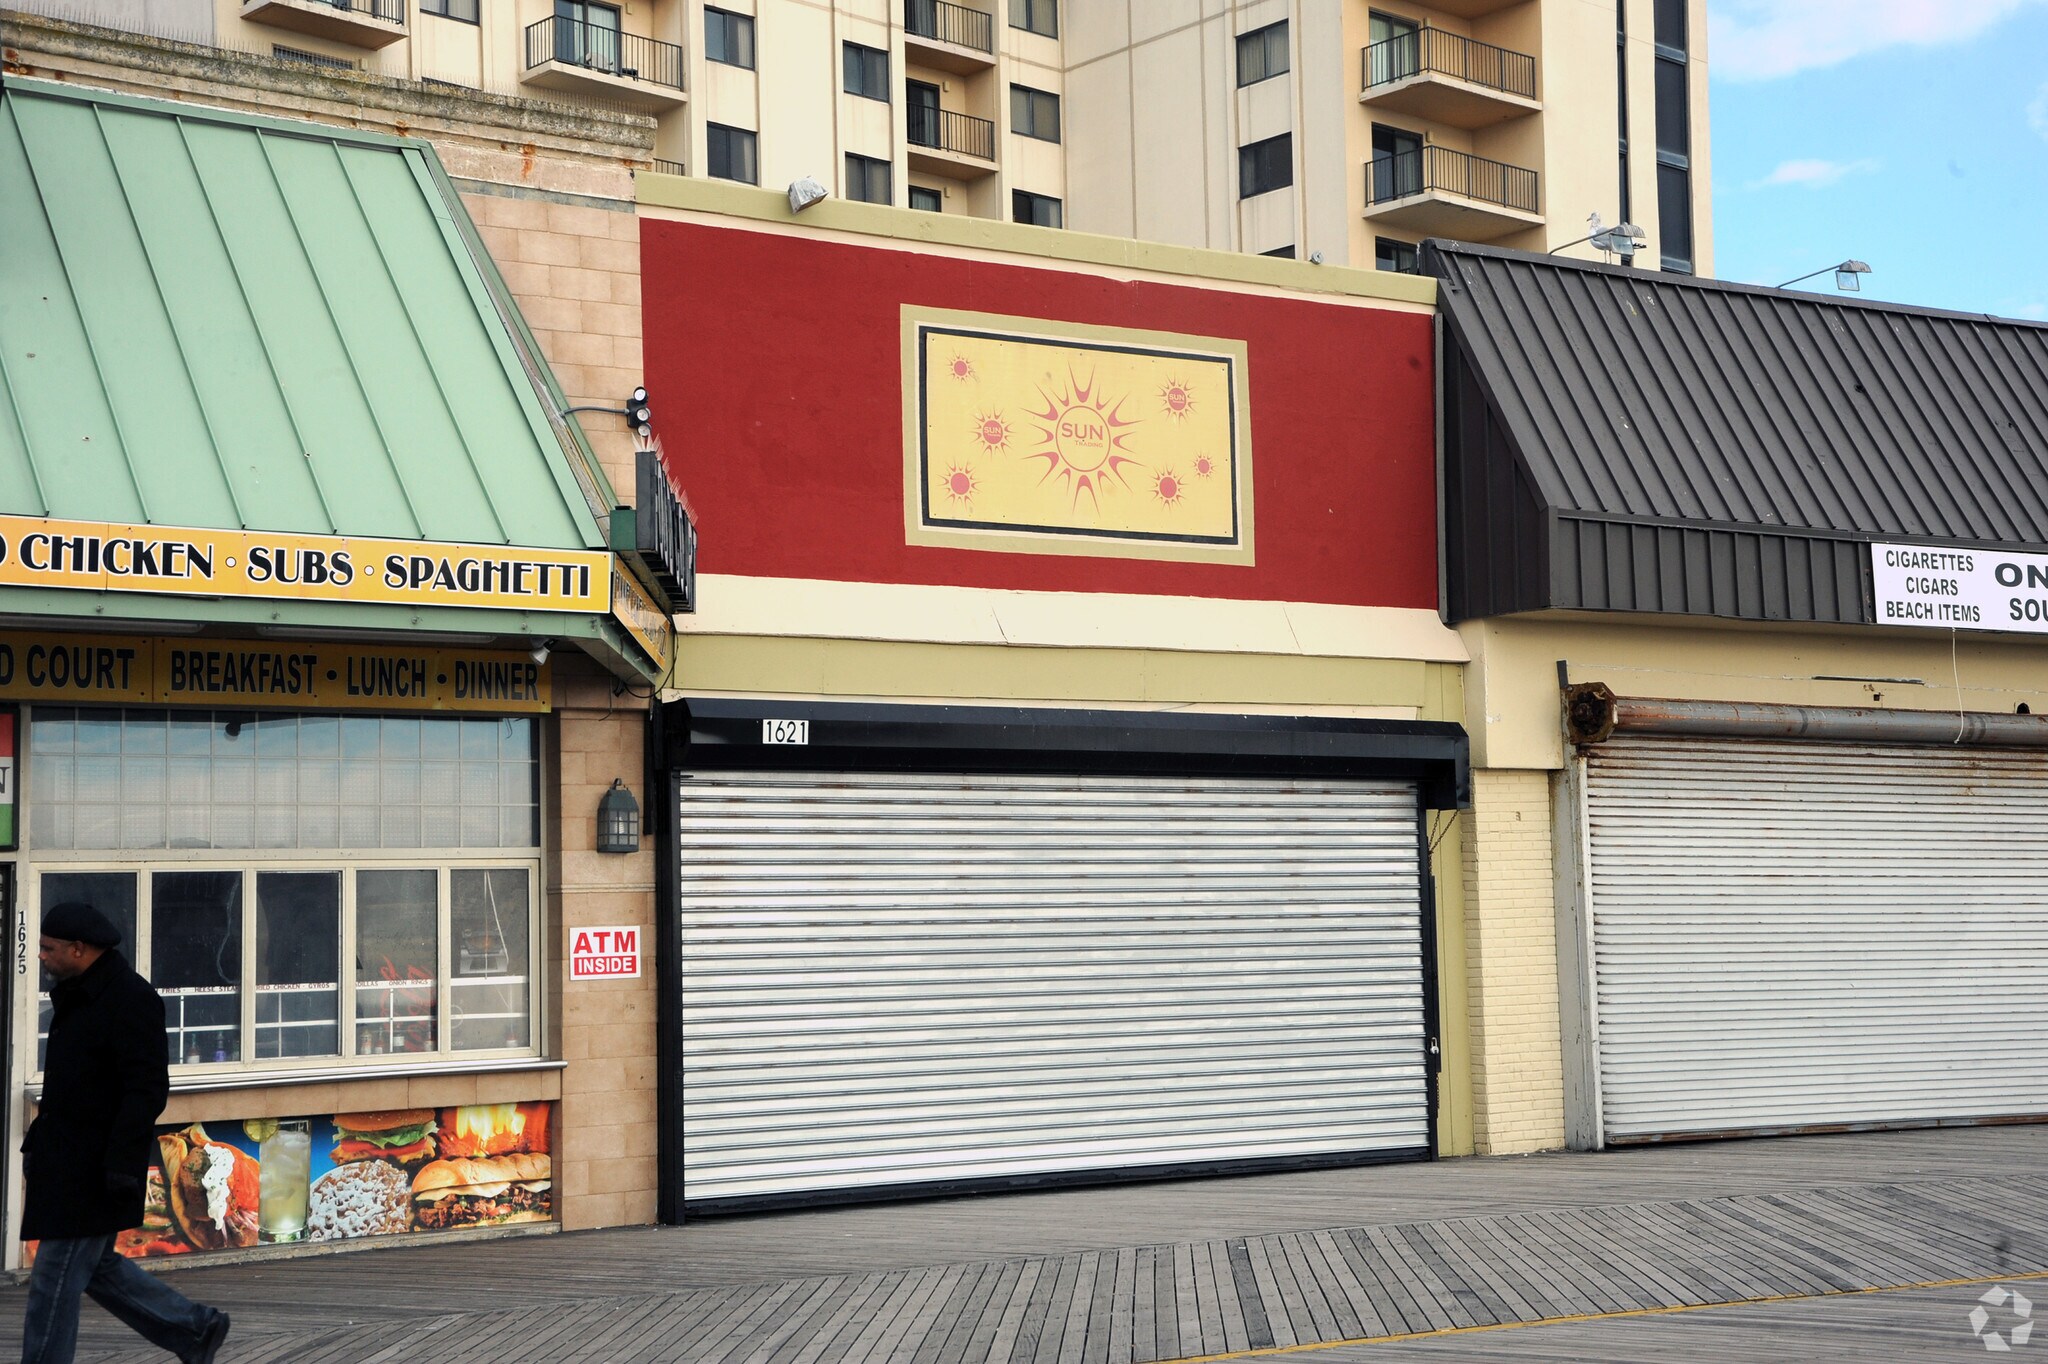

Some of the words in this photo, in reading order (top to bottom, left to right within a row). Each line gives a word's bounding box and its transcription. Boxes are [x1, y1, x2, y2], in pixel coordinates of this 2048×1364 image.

[1061, 422, 1103, 441] SUN
[19, 533, 214, 579] CHICKEN
[247, 546, 353, 586] SUBS
[383, 554, 590, 597] SPAGHETTI
[1885, 549, 1974, 572] CIGARETTES
[1906, 576, 1959, 596] CIGARS
[1886, 600, 1934, 620] BEACH
[1938, 603, 1981, 623] ITEMS
[26, 644, 135, 690] COURT
[171, 650, 317, 695] BREAKFAST
[347, 656, 426, 698] LUNCH
[455, 660, 538, 701] DINNER
[766, 720, 806, 743] 1621
[18, 910, 27, 975] 1625
[573, 930, 636, 954] ATM
[578, 957, 633, 974] INSIDE
[161, 986, 181, 994] FRIES
[273, 983, 300, 991] CHICKEN
[308, 981, 330, 990] GYROS
